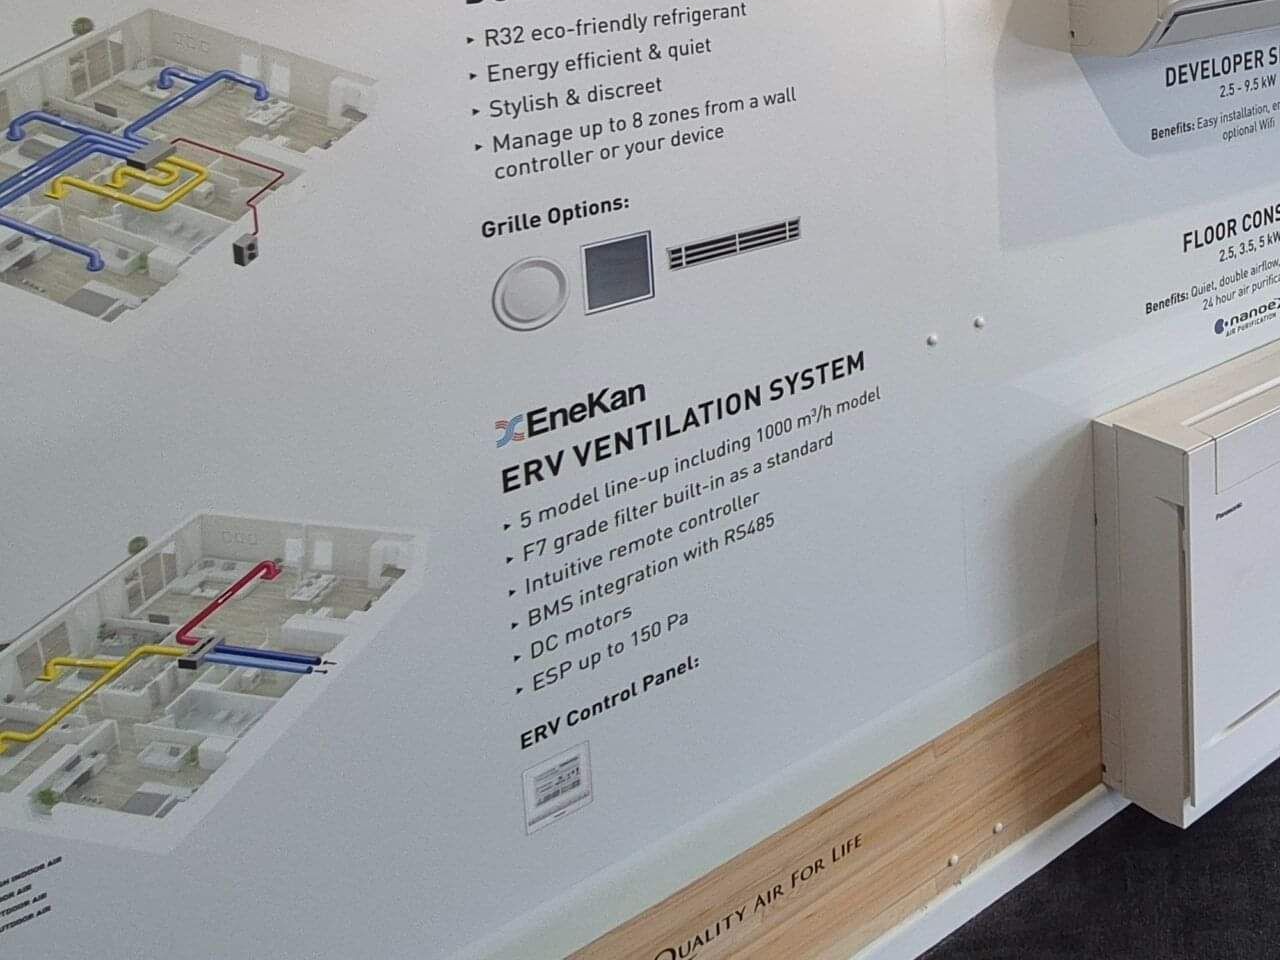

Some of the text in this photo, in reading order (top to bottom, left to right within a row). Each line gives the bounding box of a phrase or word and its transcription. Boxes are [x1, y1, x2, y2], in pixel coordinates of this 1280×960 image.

[1166, 49, 1264, 87] DEVELOPER
[1220, 85, 1235, 98] 2.5
[1244, 78, 1259, 93] 9.5
[1261, 74, 1277, 89] kW
[489, 77, 663, 119] Stylish & discreet
[493, 86, 797, 154] Manage up to 8 zones from a wall
[494, 125, 724, 180] controller or your device
[481, 196, 630, 239] Grille Options:
[1183, 218, 1237, 252] FLOOR
[1219, 248, 1237, 262] 2.5,
[1239, 239, 1257, 256] 3.5,
[1259, 235, 1265, 248] 5
[1145, 291, 1189, 315] Benefits:
[1190, 280, 1218, 298] Quiet,
[1219, 268, 1248, 288] double
[1250, 258, 1280, 276] airflow,
[1202, 298, 1214, 311] 24
[1215, 292, 1236, 307] hour
[1238, 285, 1250, 299] air
[502, 351, 865, 494] ERV VENTILATION SYSTEM
[526, 383, 646, 438] EneKan
[520, 511, 532, 529] 5
[539, 486, 600, 522] model
[605, 464, 669, 504] line-up
[674, 435, 751, 475] including
[757, 418, 793, 444] 1000
[837, 387, 881, 417] model
[523, 432, 834, 562] F7 grade filter built-in as a standard
[526, 491, 760, 595] Intuitive remote controller
[528, 512, 775, 627] BMS integration with RS485
[530, 605, 632, 660] DC motors
[533, 612, 689, 692] ESP up to 150 Pa
[521, 656, 700, 750] ERV Control Panel:
[753, 884, 784, 912] AIR
[791, 858, 825, 888] FOR
[832, 833, 862, 862] LIFE
